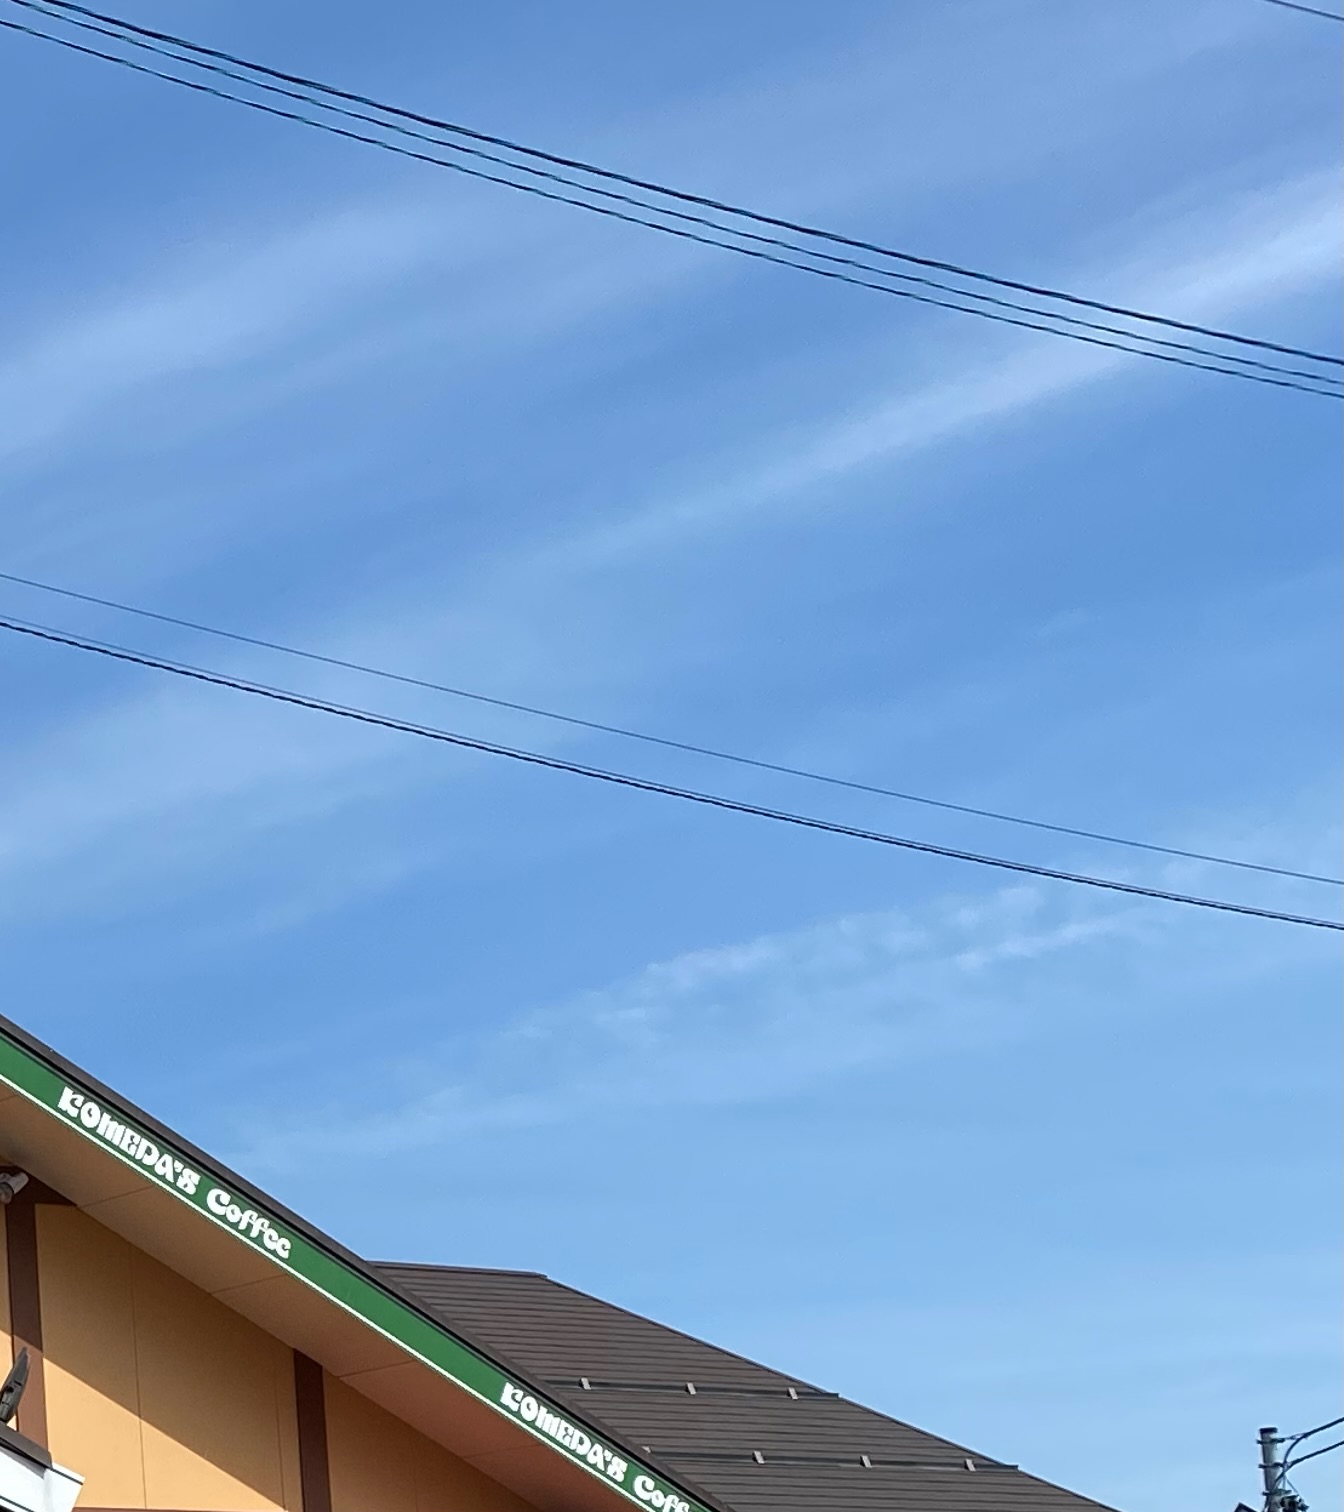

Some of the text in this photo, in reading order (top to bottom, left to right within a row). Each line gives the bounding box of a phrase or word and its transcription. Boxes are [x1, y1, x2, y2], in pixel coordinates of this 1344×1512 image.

[57, 1086, 293, 1259] KOMEDA'S Coffee
[499, 1382, 629, 1483] KOMEDA'S
